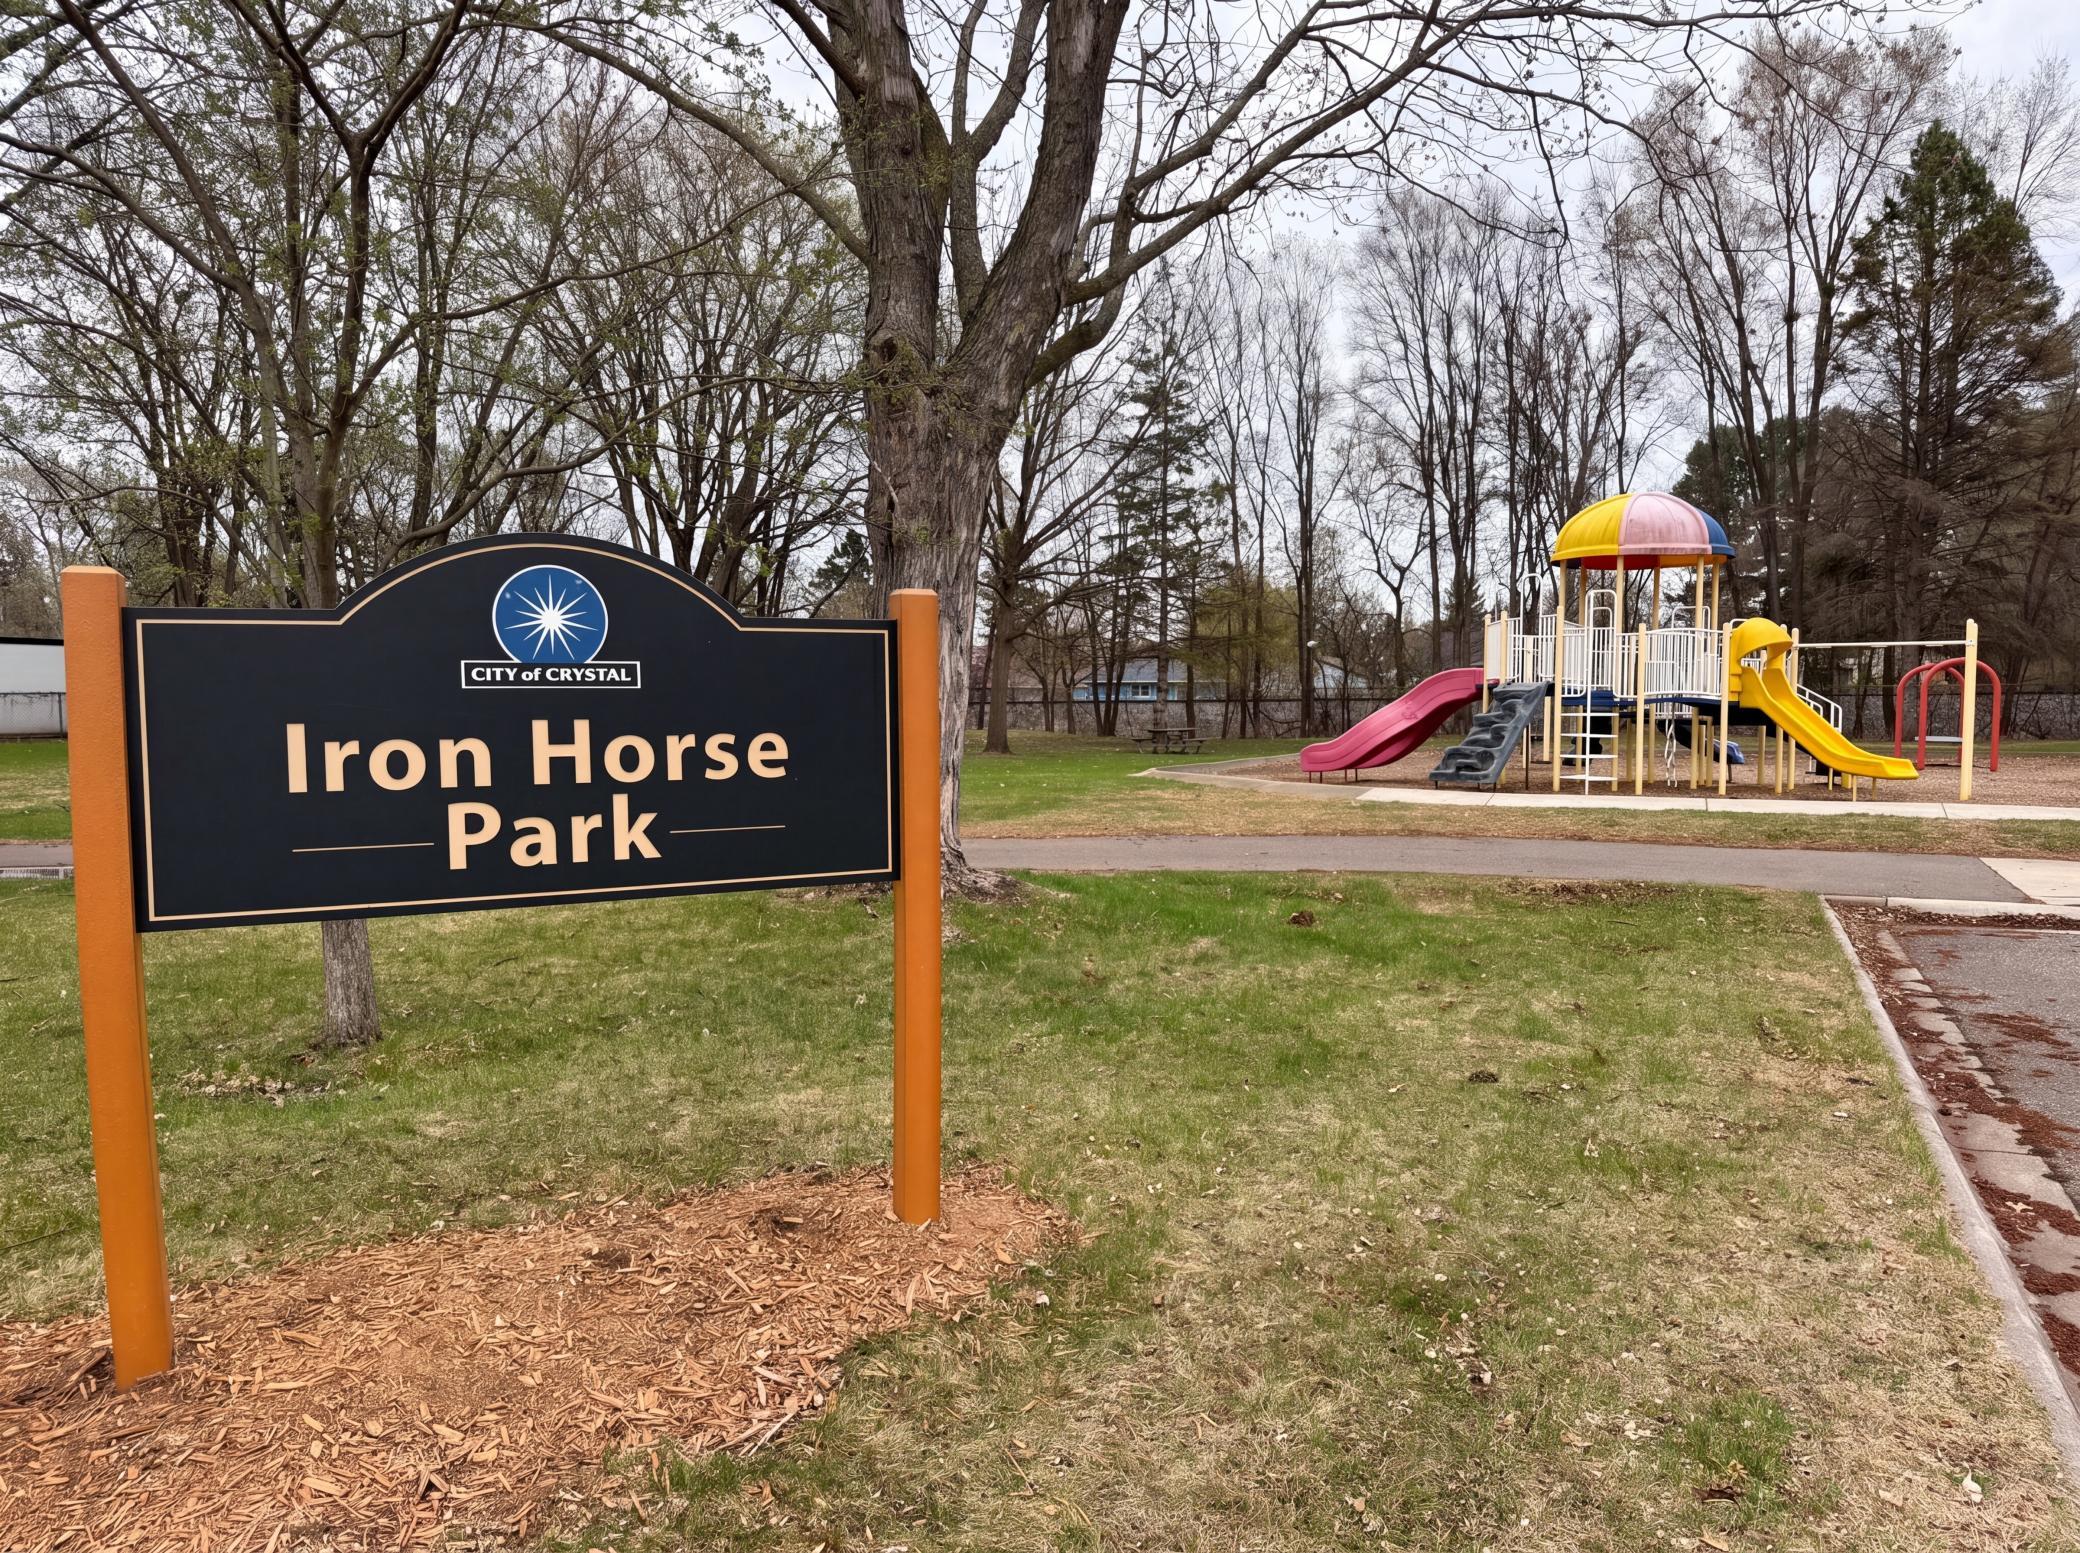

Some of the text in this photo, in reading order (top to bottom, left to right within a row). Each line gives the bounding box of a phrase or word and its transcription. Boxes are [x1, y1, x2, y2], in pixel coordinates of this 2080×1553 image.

[471, 667, 632, 681] CITY of CRYSTAL
[285, 719, 790, 794] Iron Horse
[446, 794, 662, 871] Park
